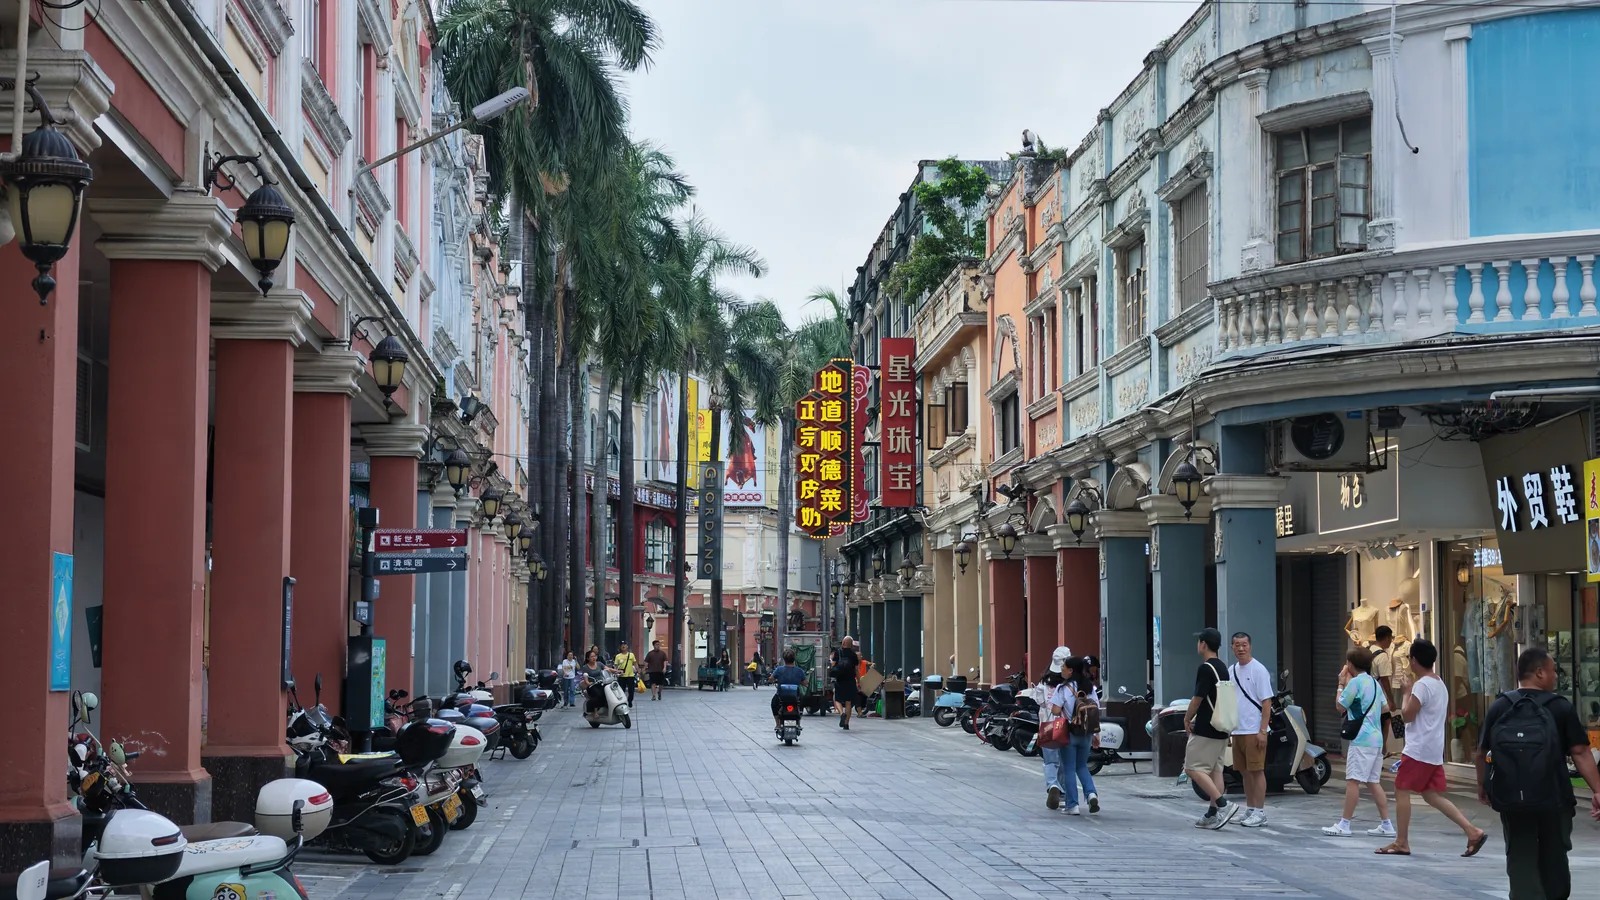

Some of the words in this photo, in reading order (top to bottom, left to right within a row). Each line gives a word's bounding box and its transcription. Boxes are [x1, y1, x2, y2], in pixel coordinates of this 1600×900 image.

[800, 400, 822, 527] 正宗双皮奶
[819, 370, 842, 512] 地道顺德菜
[887, 354, 912, 490] 星光珠宝
[393, 534, 423, 543] 新世界
[703, 466, 717, 574] GIORDANO
[1496, 464, 1579, 533] 外贸鞋
